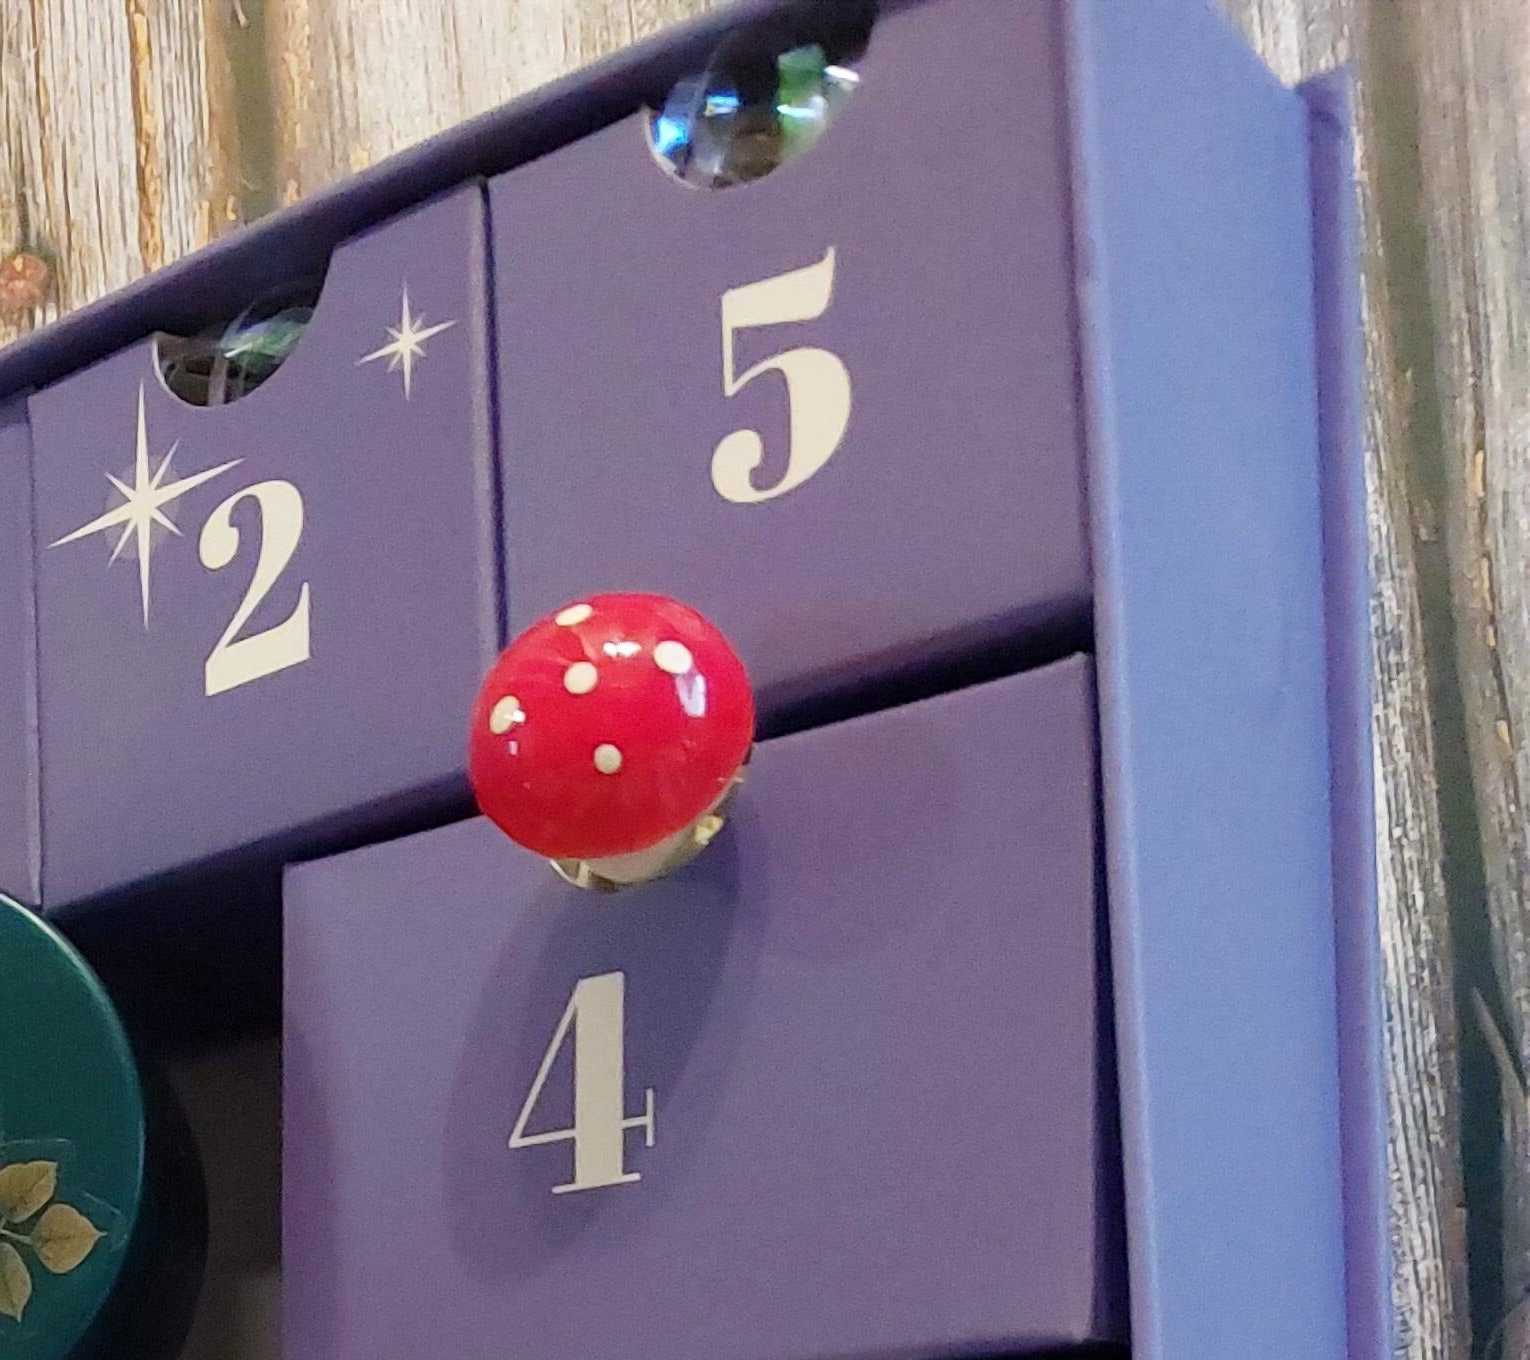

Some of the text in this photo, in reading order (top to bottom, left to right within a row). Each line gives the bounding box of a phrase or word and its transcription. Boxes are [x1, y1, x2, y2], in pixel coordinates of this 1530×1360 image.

[712, 247, 850, 502] 5
[199, 479, 310, 696] 2
[509, 972, 654, 1193] 4
